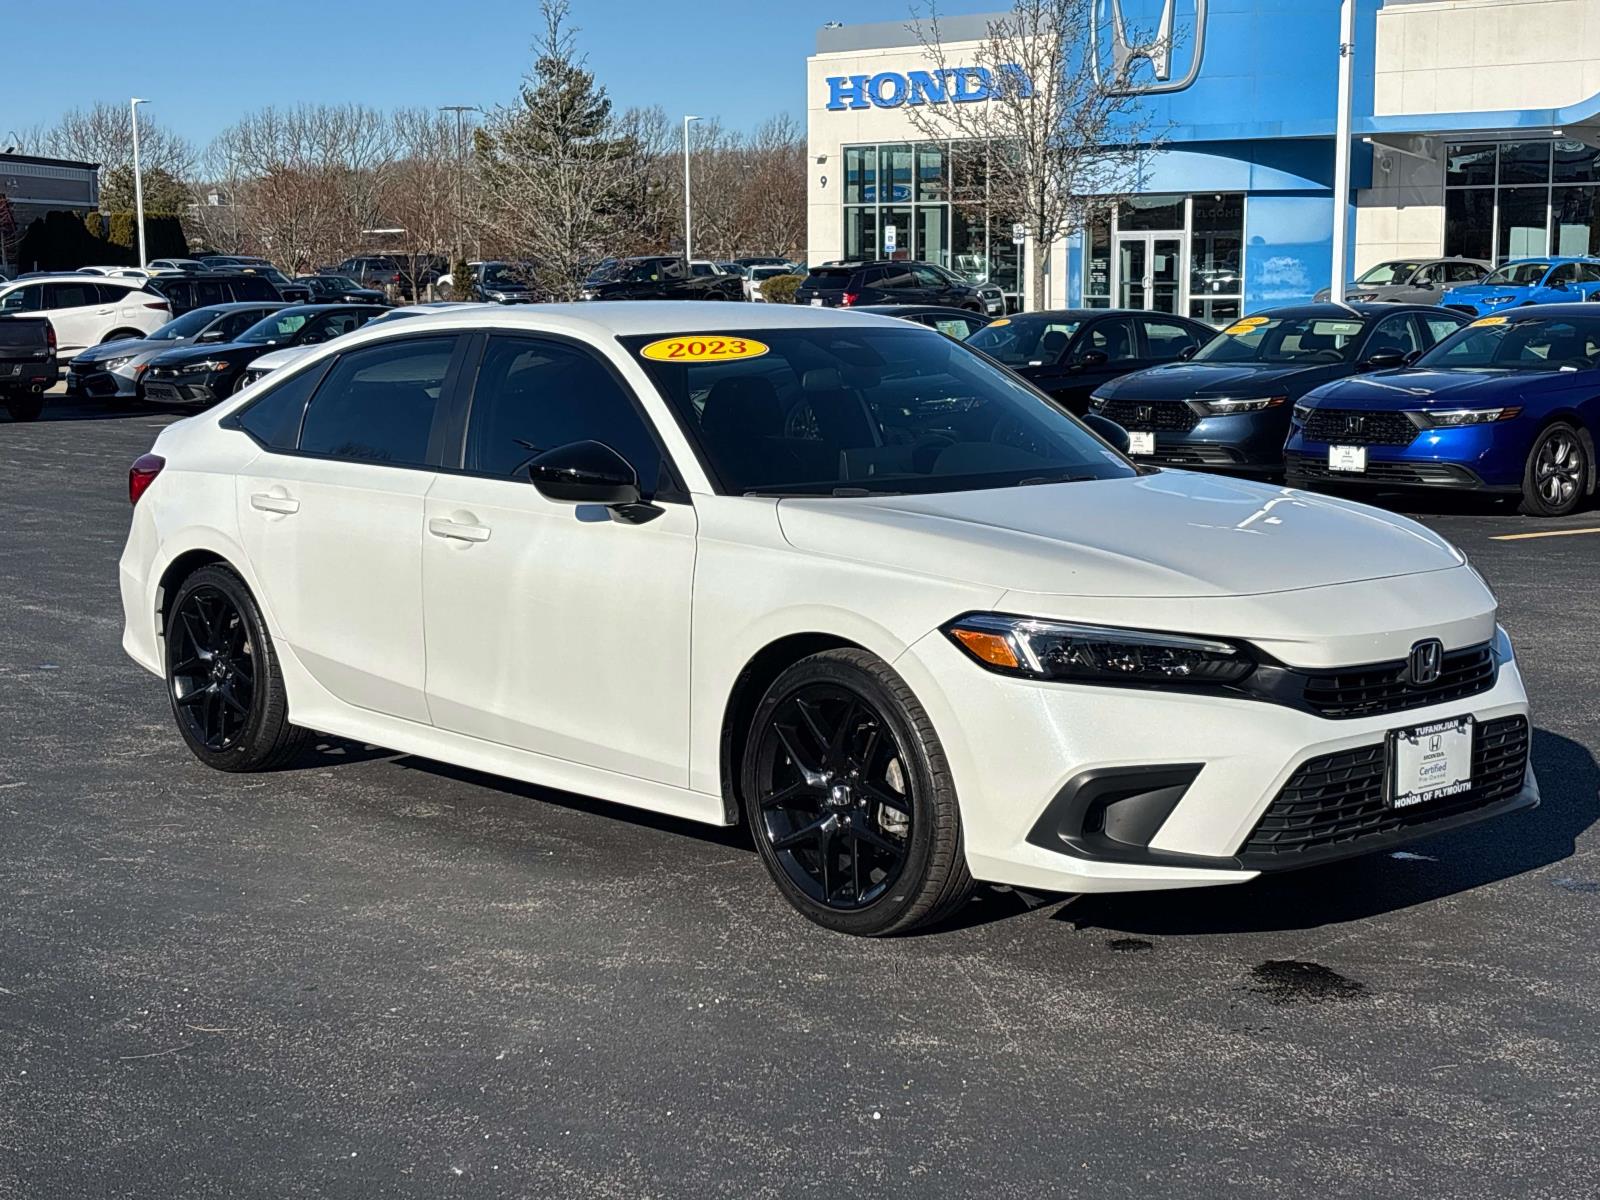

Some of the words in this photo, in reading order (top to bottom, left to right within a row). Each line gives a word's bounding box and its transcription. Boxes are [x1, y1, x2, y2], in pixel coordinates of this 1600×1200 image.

[825, 64, 1040, 111] HONDA
[820, 175, 828, 188] 9
[667, 340, 747, 358] 2023
[1415, 720, 1459, 736] TUFANKJIAN
[1419, 762, 1447, 776] Certified
[1394, 796, 1421, 808] HONDA
[1423, 791, 1433, 801] OF
[1434, 782, 1471, 799] PLYMOUTH
